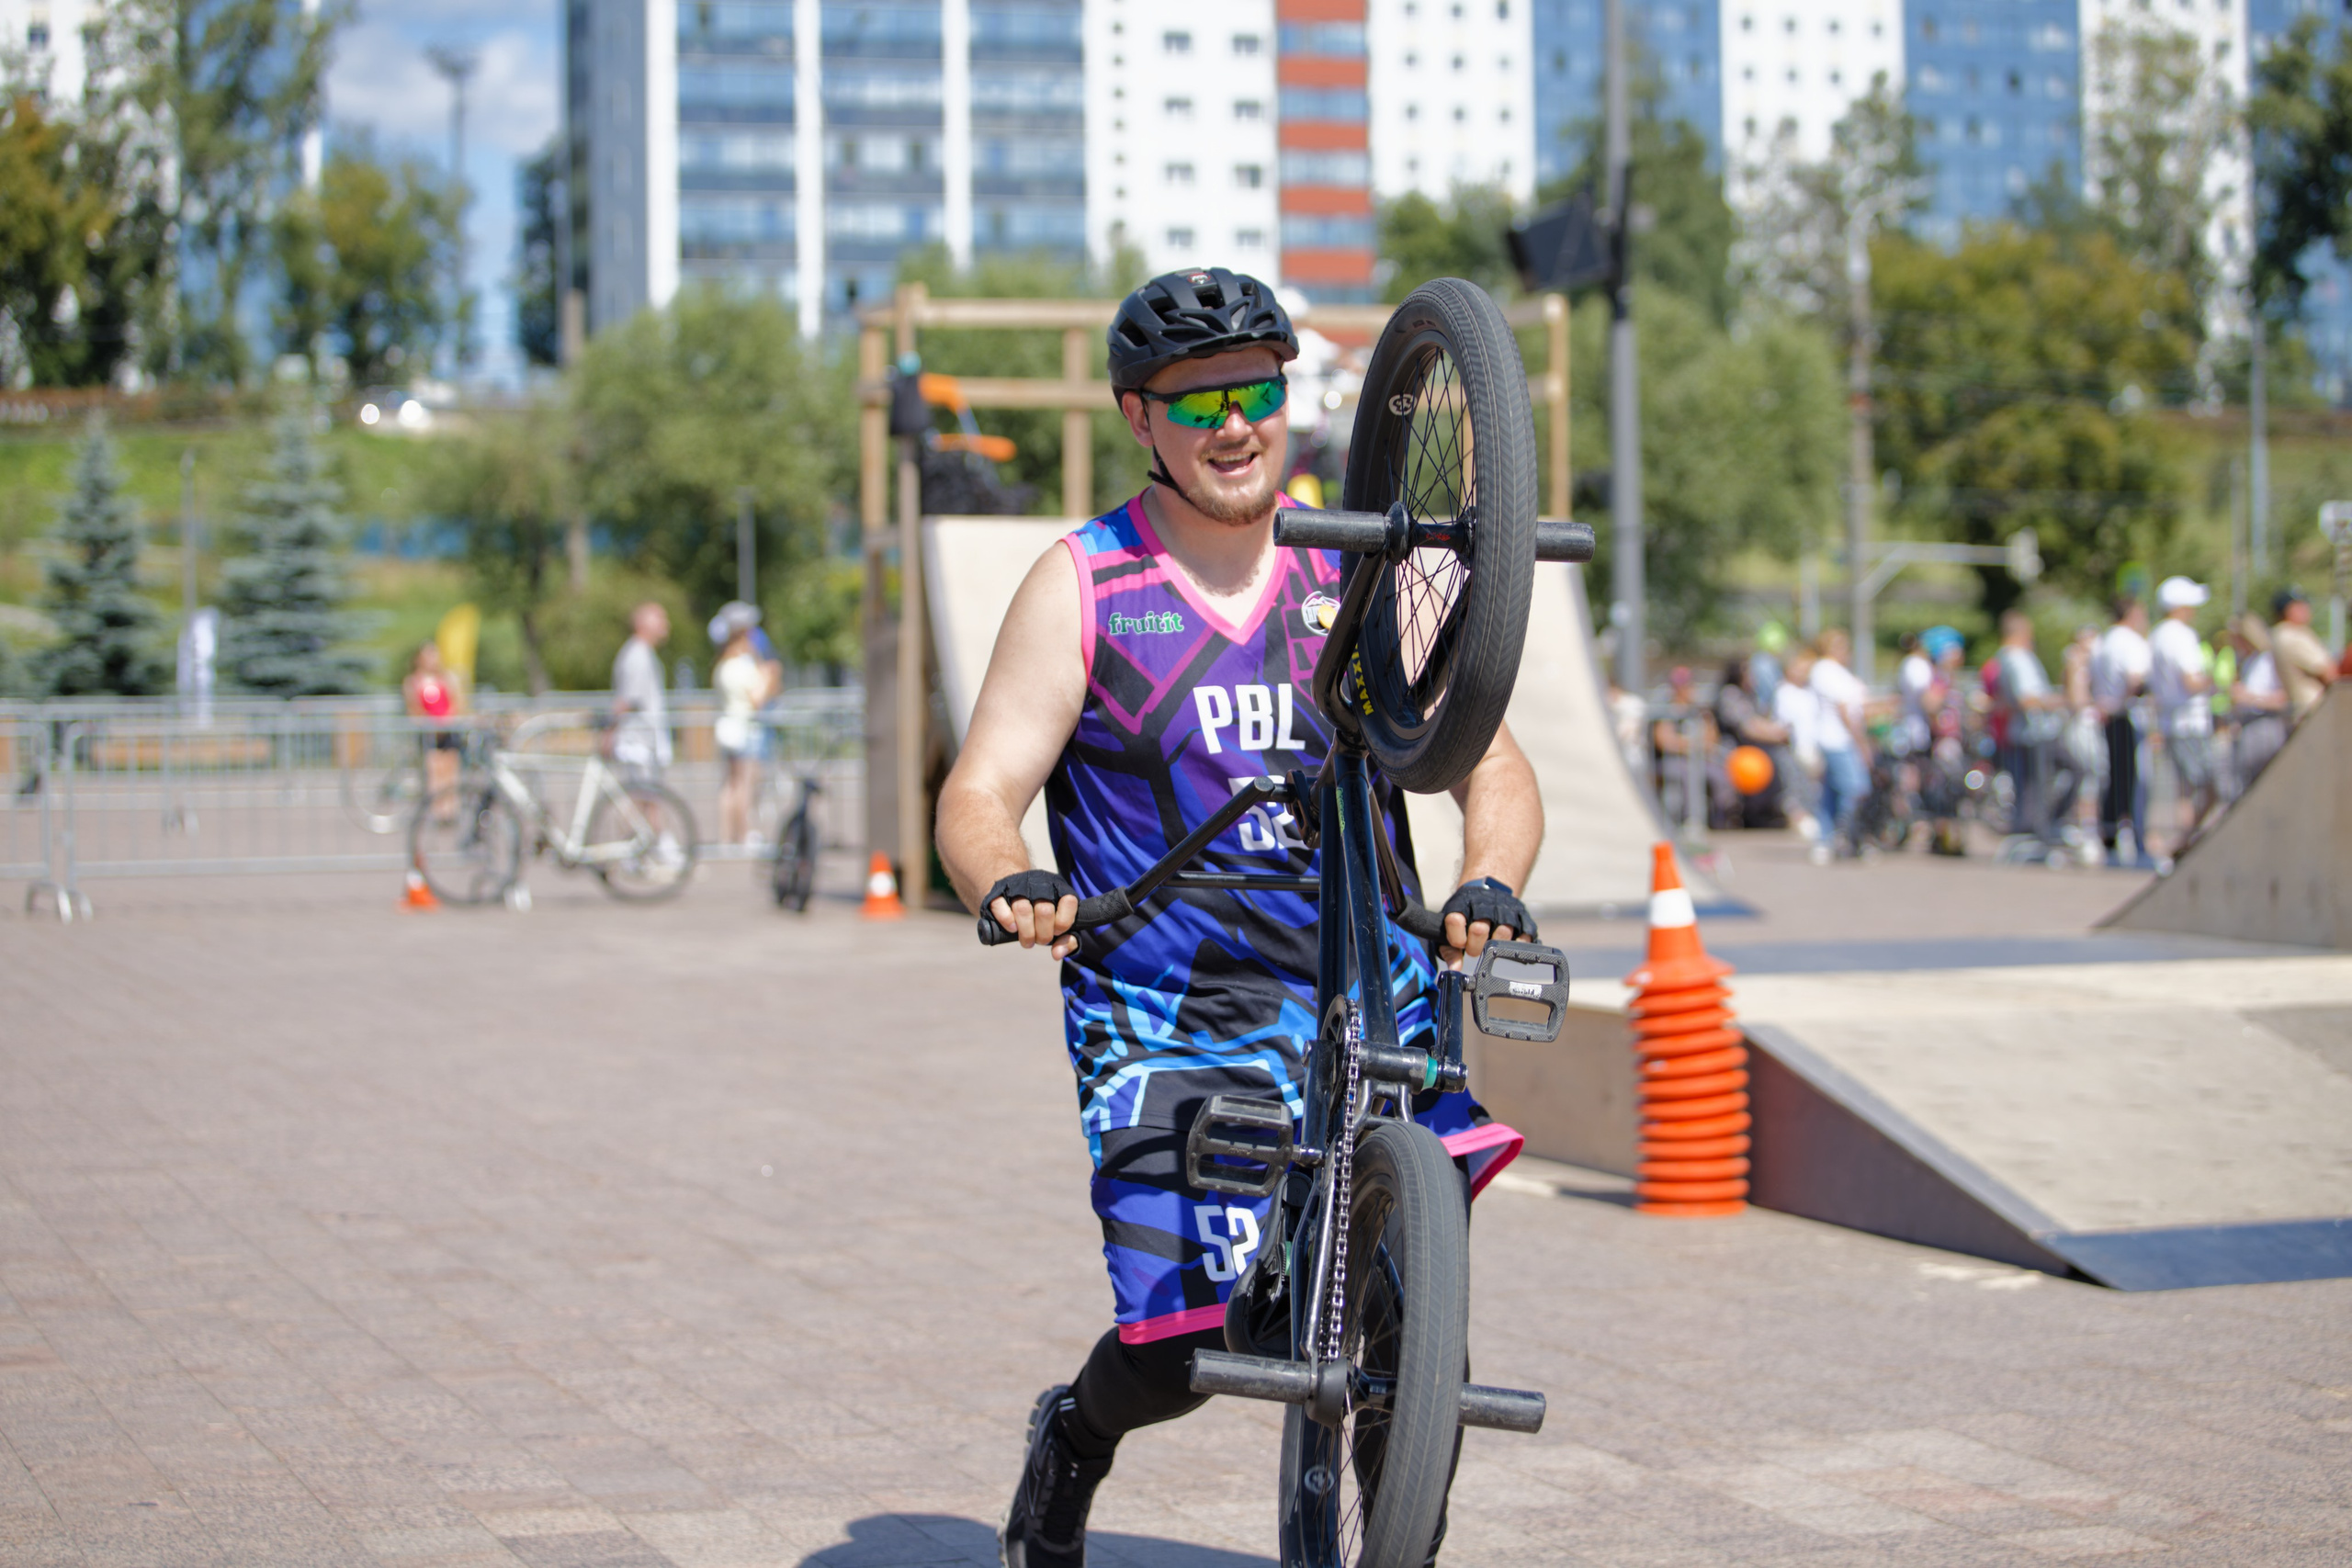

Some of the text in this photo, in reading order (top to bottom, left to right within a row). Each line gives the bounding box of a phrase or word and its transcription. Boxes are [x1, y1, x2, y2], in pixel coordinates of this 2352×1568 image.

[1108, 610, 1184, 636] fruitit
[1351, 643, 1374, 716] MAXXI
[1193, 683, 1306, 754] PBL
[1193, 1204, 1260, 1282] 52
